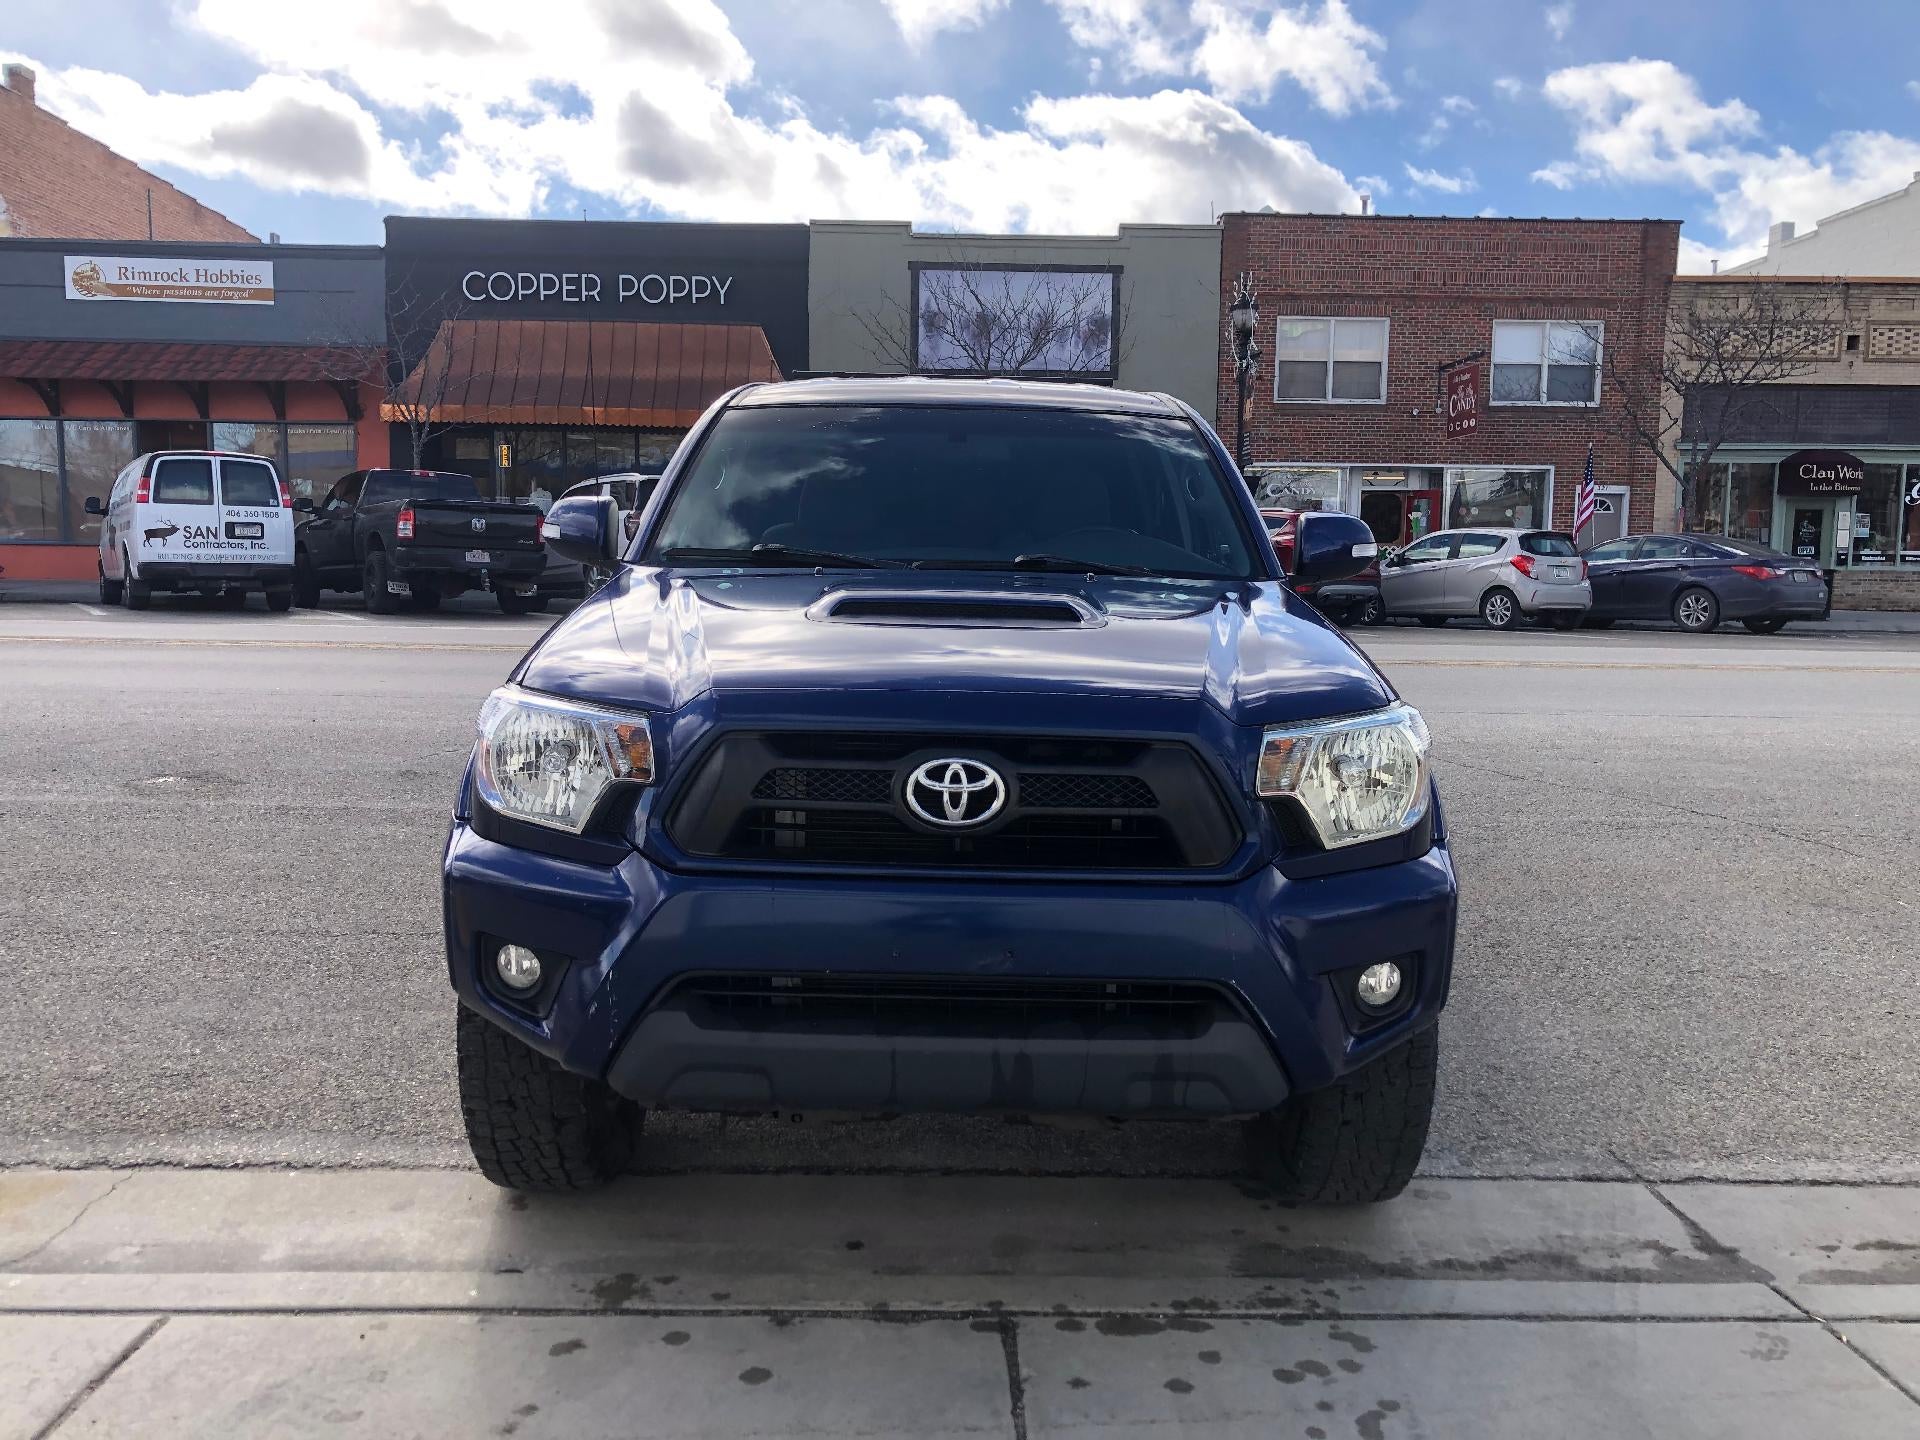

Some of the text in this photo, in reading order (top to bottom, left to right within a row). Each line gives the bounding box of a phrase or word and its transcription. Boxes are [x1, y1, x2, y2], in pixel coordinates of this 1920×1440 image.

[116, 265, 263, 285] Rimrock Hobbies
[163, 287, 203, 299] passions
[204, 290, 219, 298] are
[462, 271, 733, 305] COPPER POPPY
[1449, 394, 1477, 417] CANDY
[1799, 463, 1835, 481] Clay
[1266, 483, 1316, 497] CANDY
[1810, 482, 1819, 491] In
[1819, 482, 1833, 491] the
[225, 509, 241, 518] 406
[183, 525, 218, 540] SAN
[183, 540, 269, 550] Contractors, Inc.
[203, 553, 247, 561] CARPENTRY
